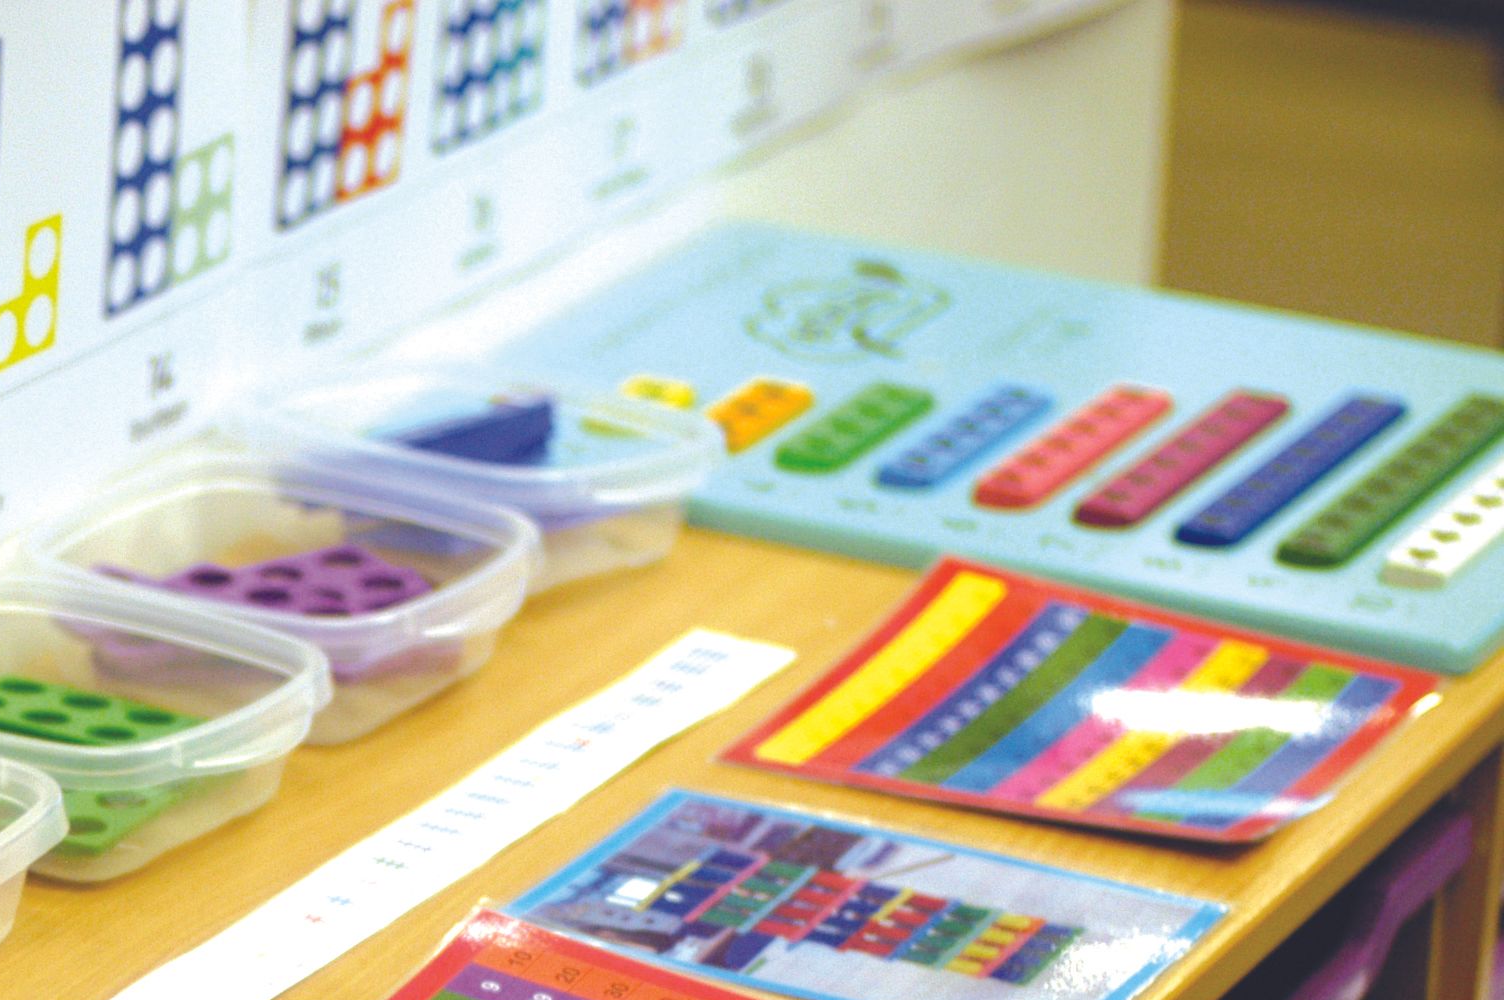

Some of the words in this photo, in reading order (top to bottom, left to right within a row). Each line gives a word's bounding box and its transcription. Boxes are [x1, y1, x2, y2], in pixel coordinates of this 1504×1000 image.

[480, 980, 500, 991] 9
[508, 951, 531, 964] 10
[555, 967, 579, 983] 20
[604, 983, 629, 997] 30
